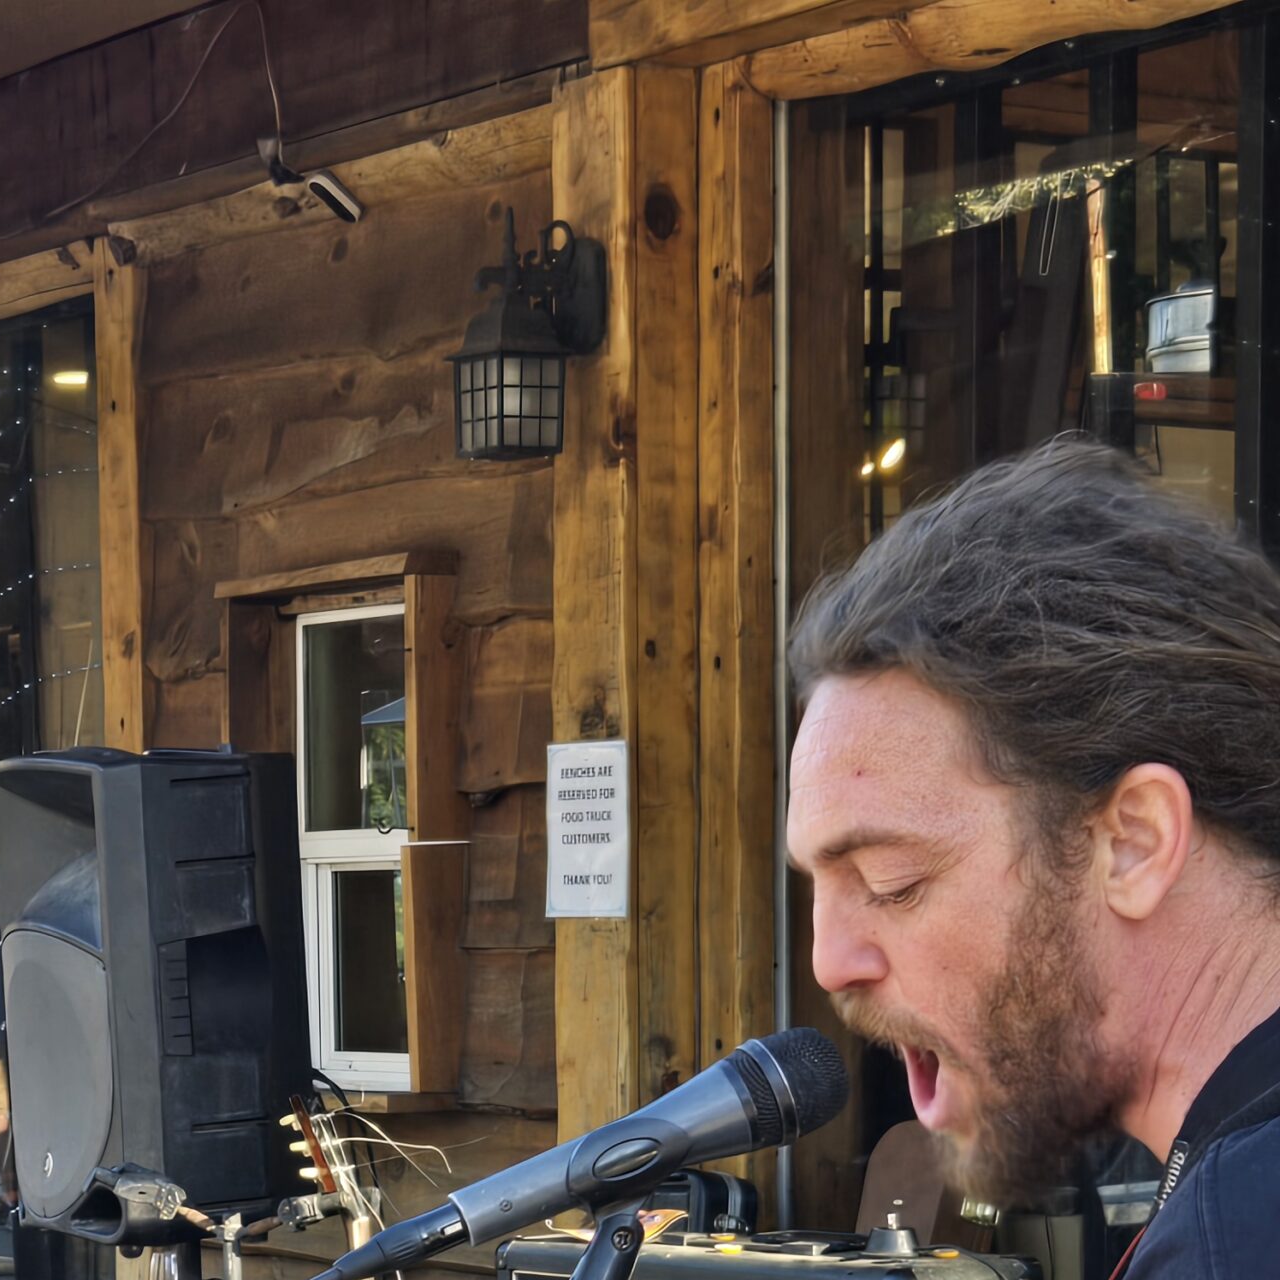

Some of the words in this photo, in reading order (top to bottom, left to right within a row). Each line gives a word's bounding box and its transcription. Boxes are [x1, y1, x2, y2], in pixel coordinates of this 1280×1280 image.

[597, 765, 614, 777] ARE
[599, 787, 615, 799] FOR
[561, 811, 584, 823] FOOD
[586, 810, 612, 821] TRUCK
[561, 833, 611, 845] CUSTOMERS
[563, 874, 590, 885] THANK
